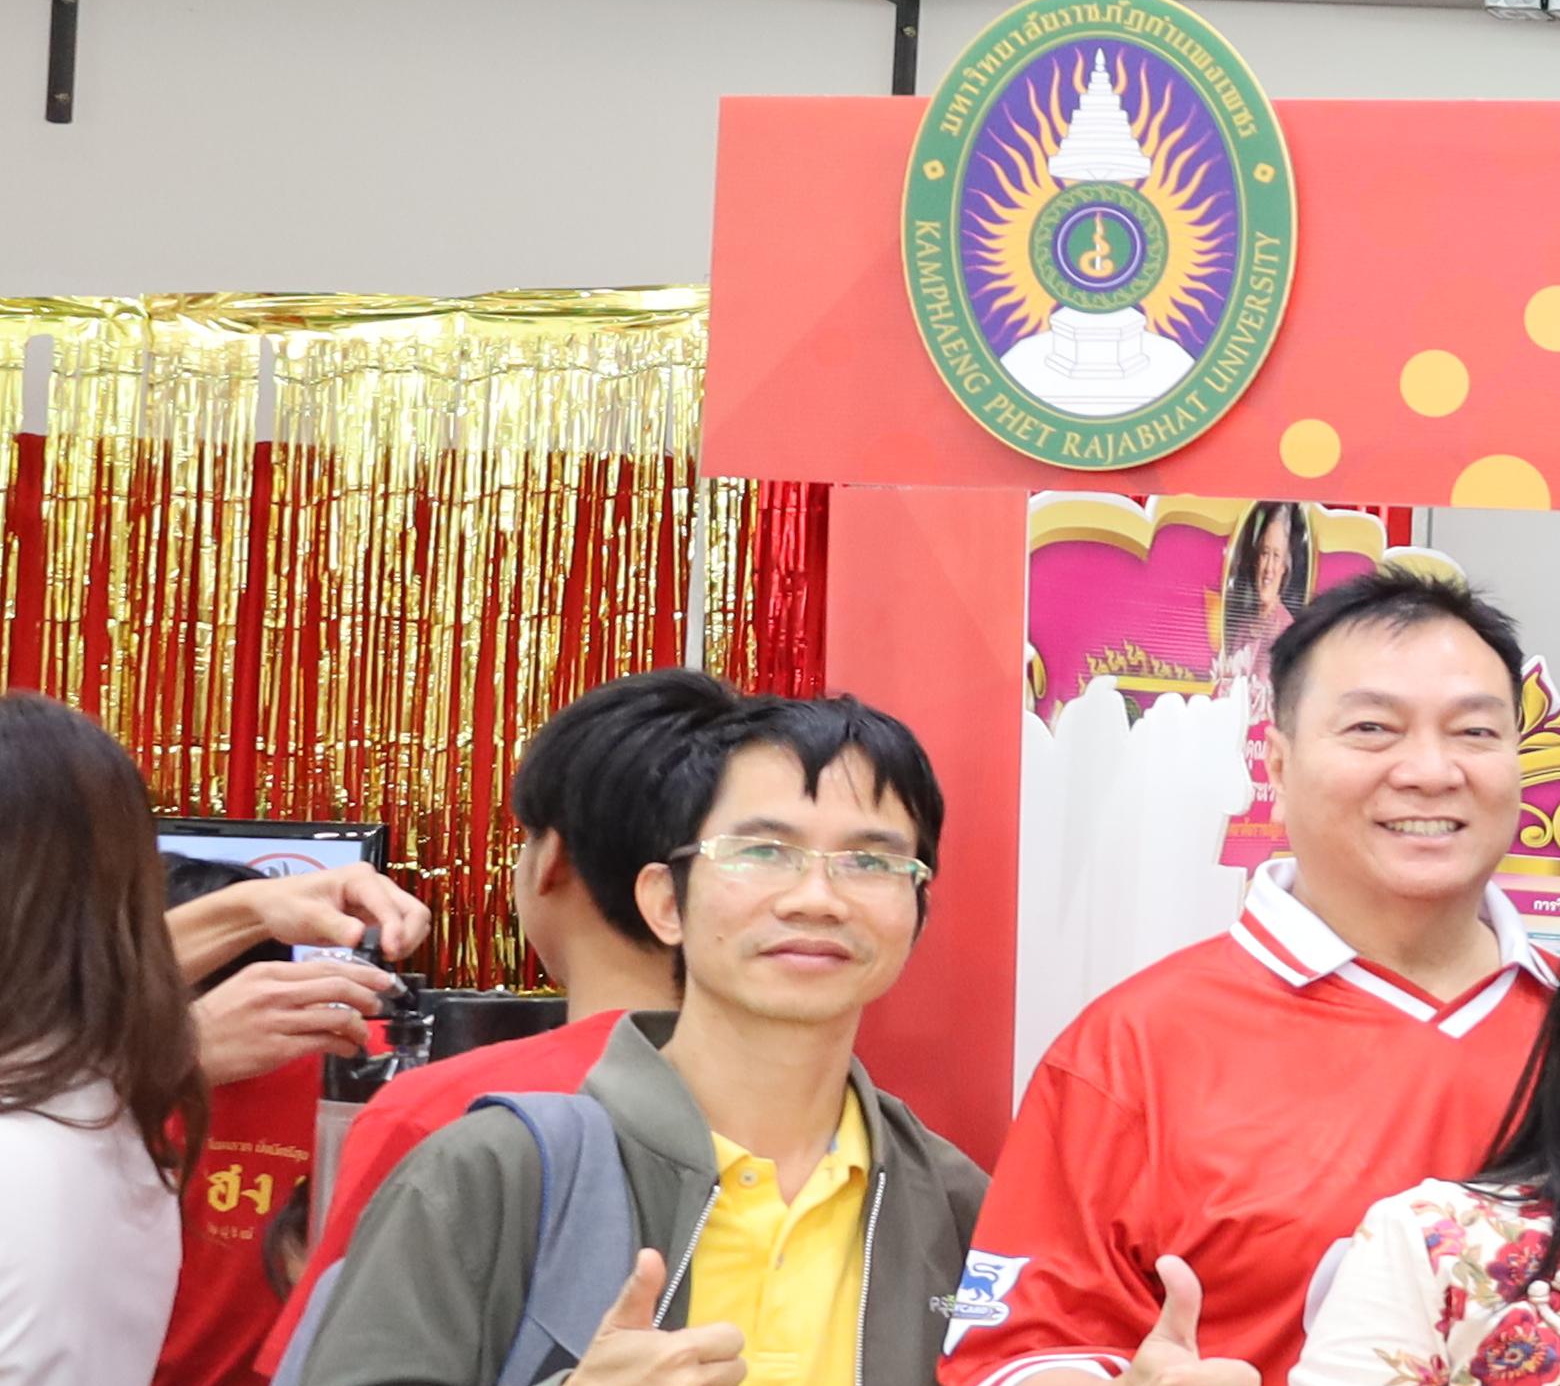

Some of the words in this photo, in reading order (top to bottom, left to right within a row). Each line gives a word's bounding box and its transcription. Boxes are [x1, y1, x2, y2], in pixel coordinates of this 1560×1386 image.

[915, 220, 993, 396] KAMPHAENG
[982, 393, 1057, 449] PHET
[1061, 389, 1211, 464] RAJABHAT
[1203, 231, 1282, 395] UNIVERSITY
